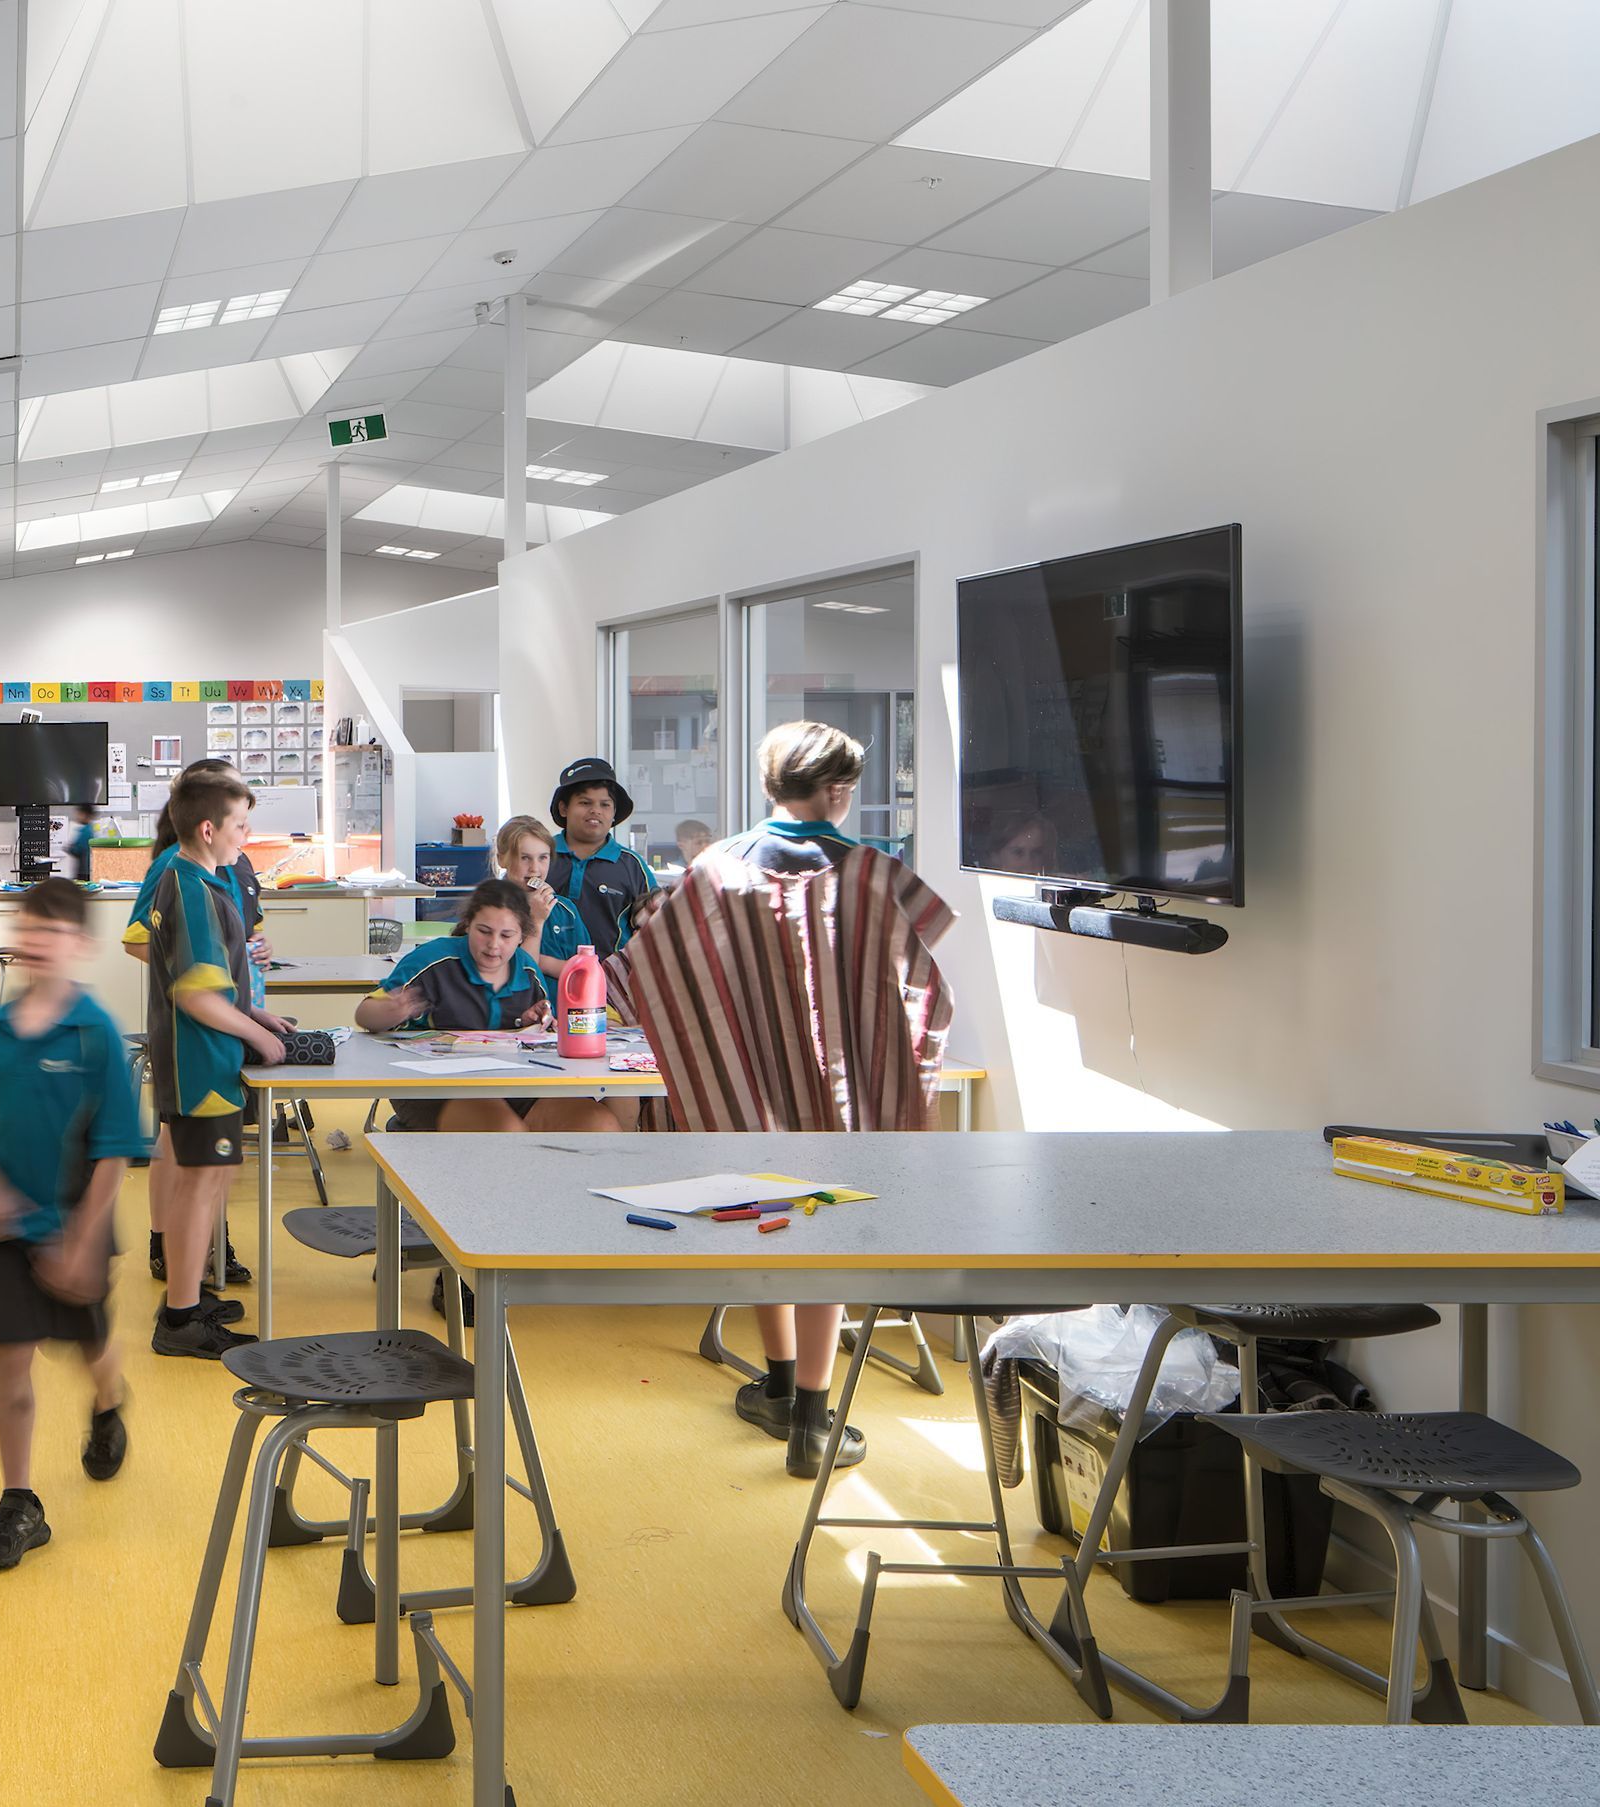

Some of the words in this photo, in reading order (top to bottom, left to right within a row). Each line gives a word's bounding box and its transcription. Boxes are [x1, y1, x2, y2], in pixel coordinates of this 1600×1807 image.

[8, 688, 24, 699] Nn
[37, 688, 55, 698] Oo
[66, 687, 82, 700] Pp
[92, 687, 110, 700] Qq
[123, 687, 135, 697] Rr
[150, 686, 165, 698] Ss
[180, 686, 190, 697] Tt
[204, 686, 221, 697] Uu
[233, 686, 248, 696] Vv
[289, 686, 303, 697] Xx
